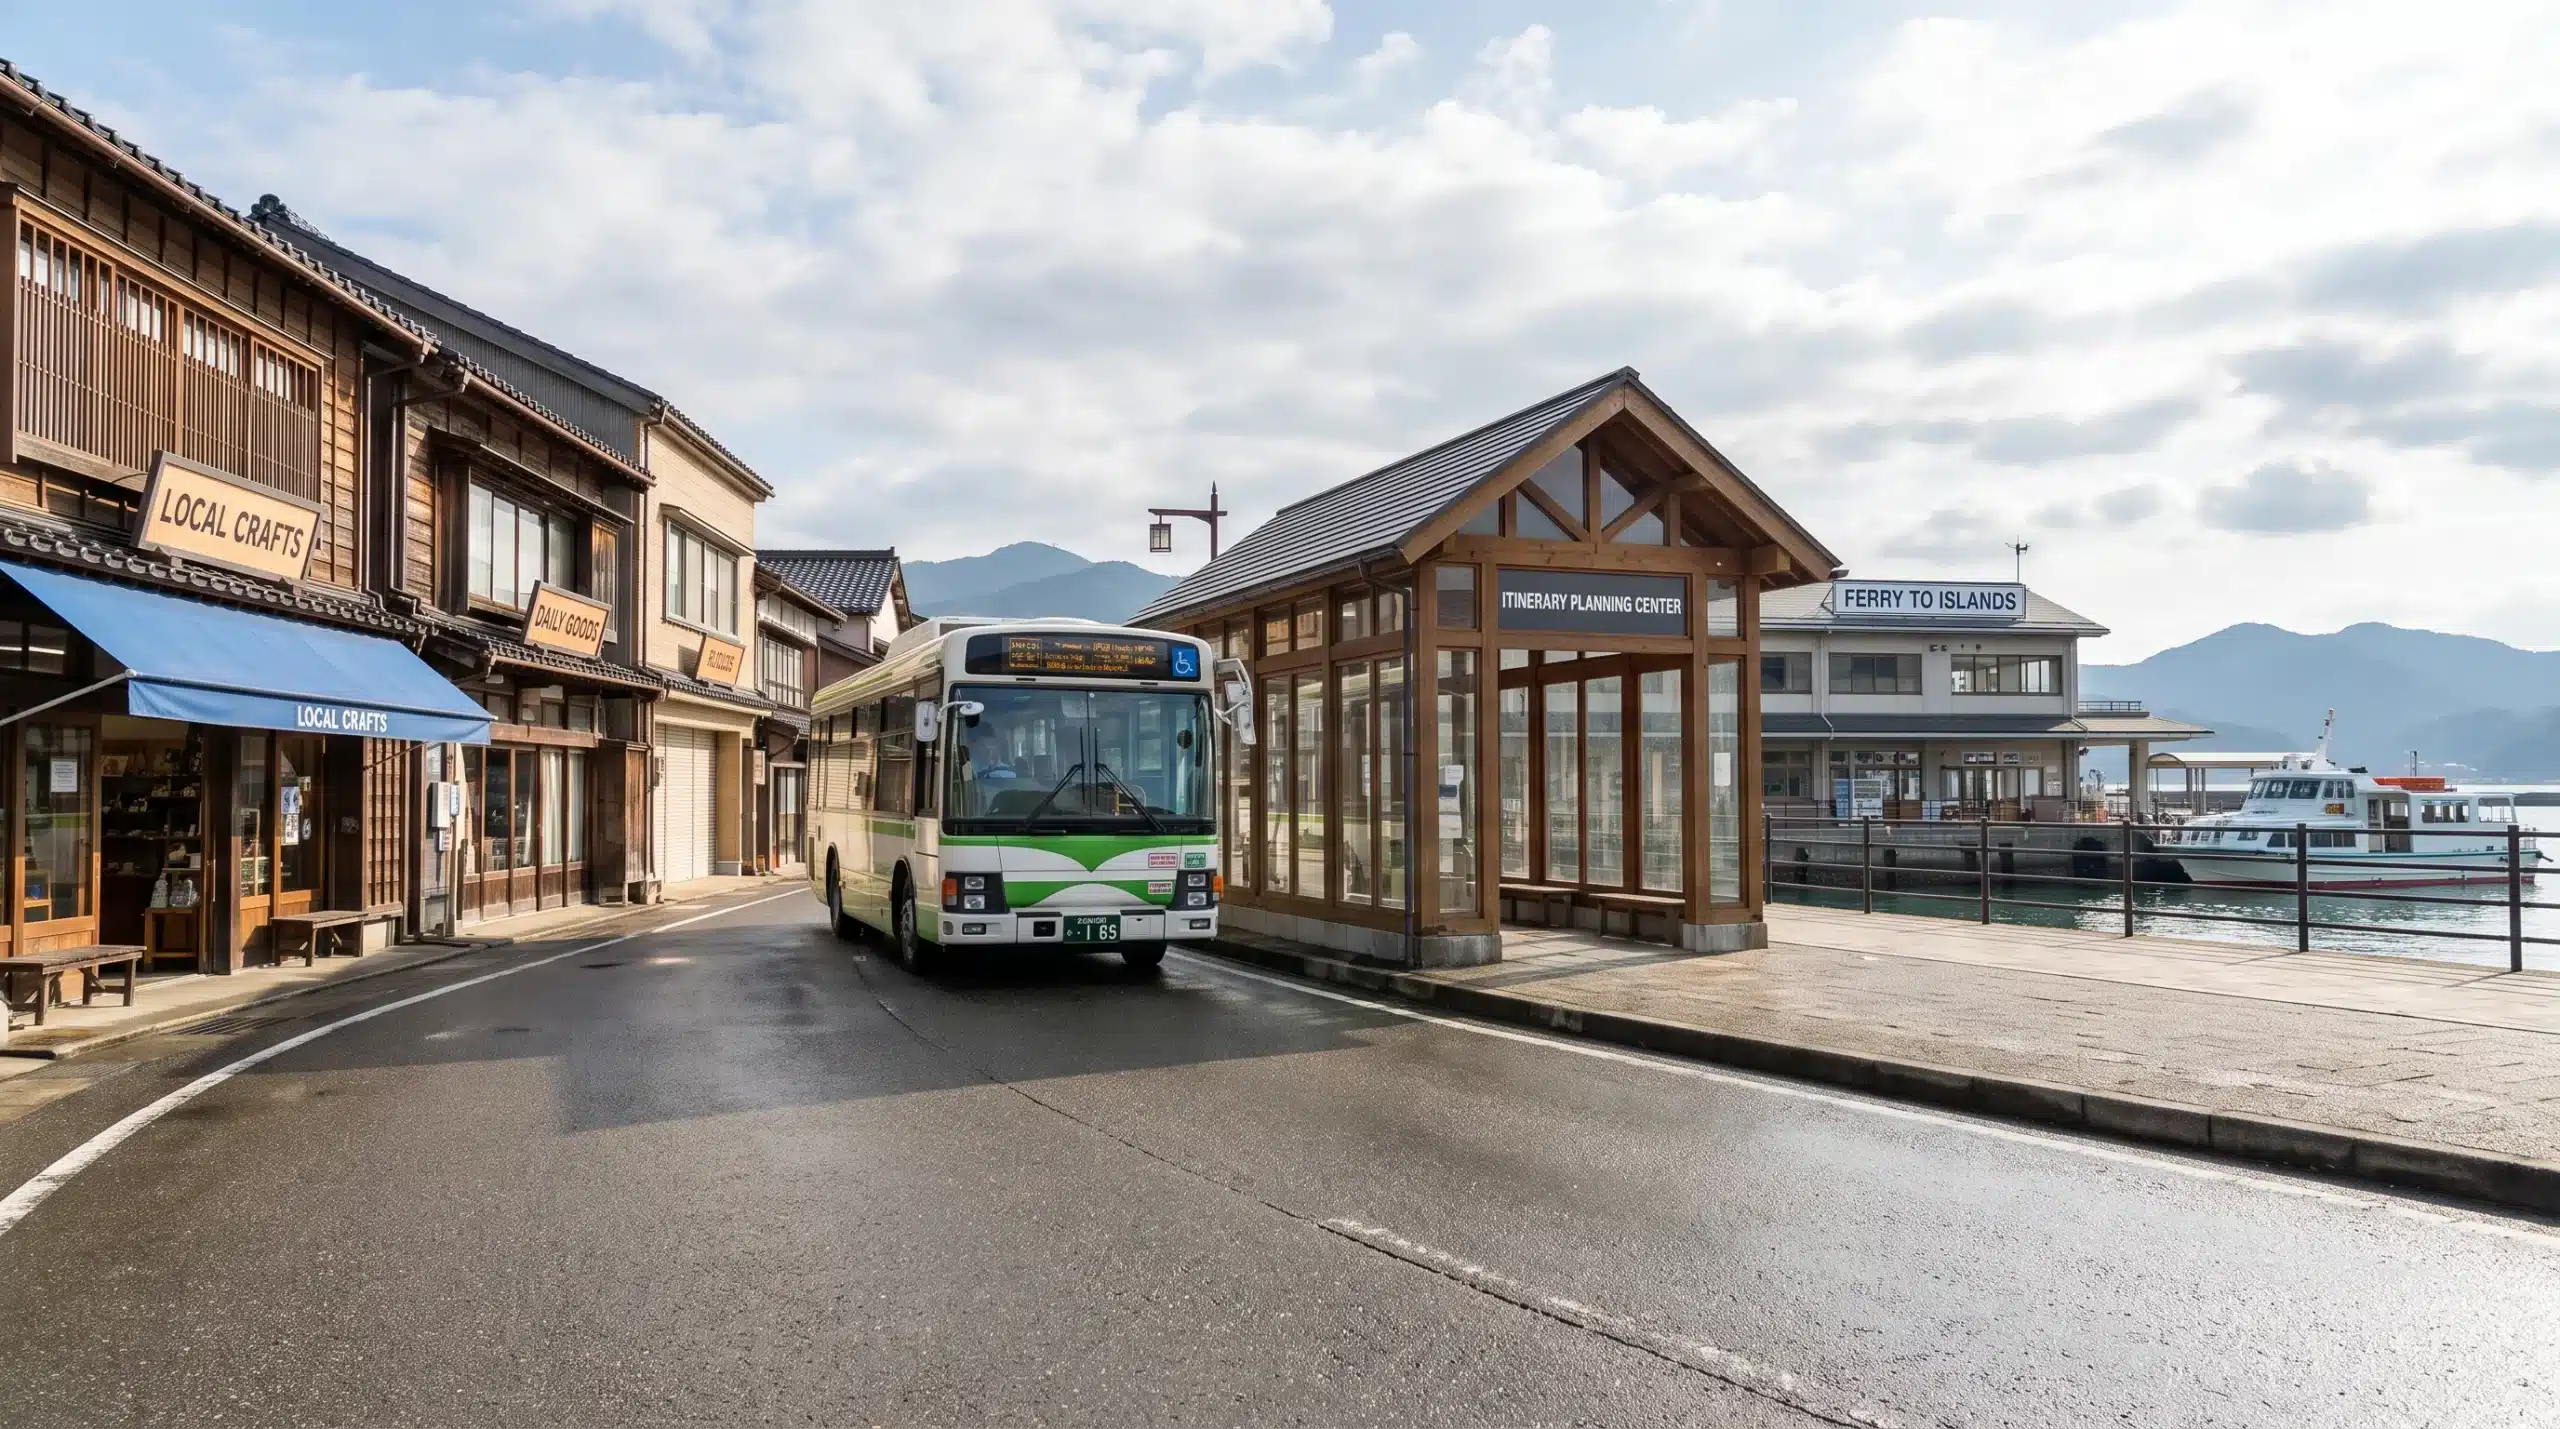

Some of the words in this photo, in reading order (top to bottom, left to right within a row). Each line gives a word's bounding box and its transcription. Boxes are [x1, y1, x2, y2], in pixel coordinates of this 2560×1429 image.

[160, 488, 227, 538] LOCAL
[234, 511, 304, 558] CRAFTS
[1502, 591, 1567, 610] ITINERARY
[1570, 594, 1632, 613] PLANNING
[1635, 597, 1682, 614] CENTER
[1844, 589, 1904, 608] FERRY
[1909, 590, 1933, 609] TO
[1939, 591, 2017, 610] ISLANDS
[535, 604, 567, 632] DAILY
[565, 613, 600, 641] GOODS
[297, 705, 339, 729] LOCAL
[342, 709, 387, 733] CRAFTS
